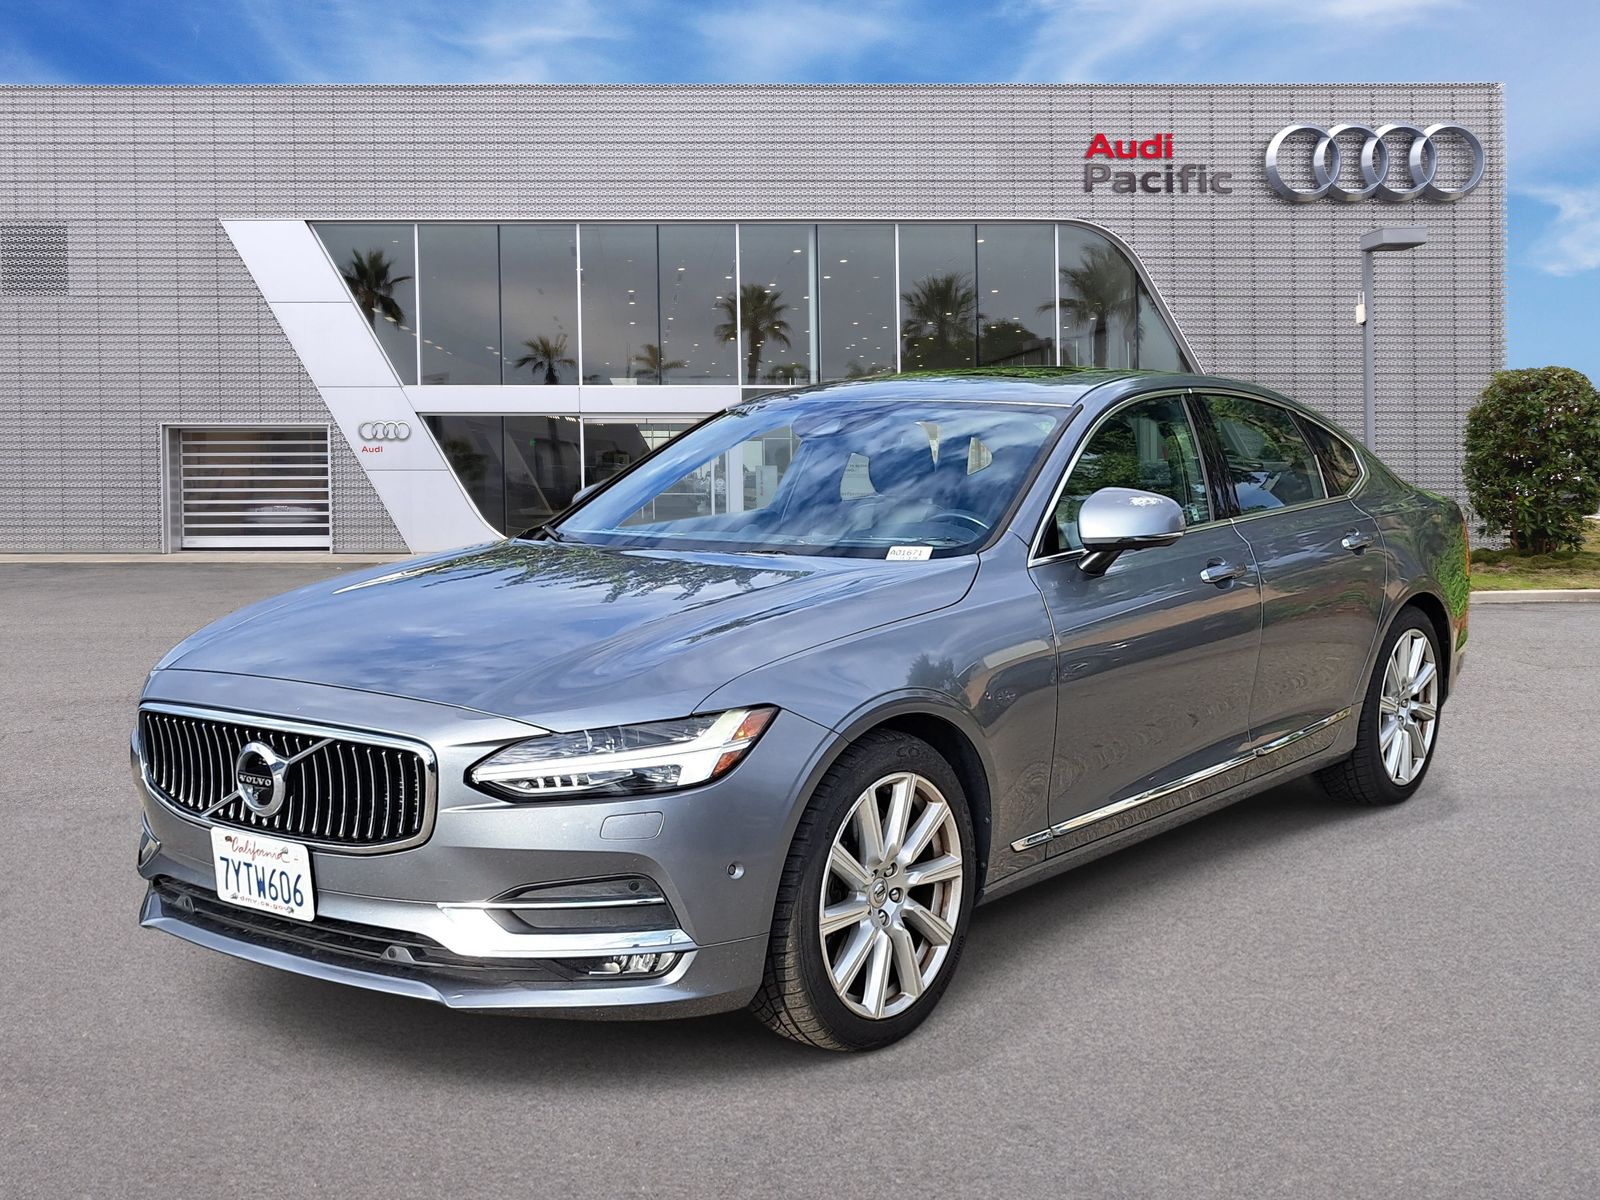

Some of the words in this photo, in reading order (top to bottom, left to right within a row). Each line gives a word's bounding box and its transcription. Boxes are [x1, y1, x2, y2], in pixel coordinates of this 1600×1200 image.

[1085, 133, 1174, 159] Audi
[1084, 162, 1233, 195] Pacific
[239, 774, 272, 787] VOLVO
[231, 836, 290, 864] California
[219, 855, 304, 908] 7YTW606
